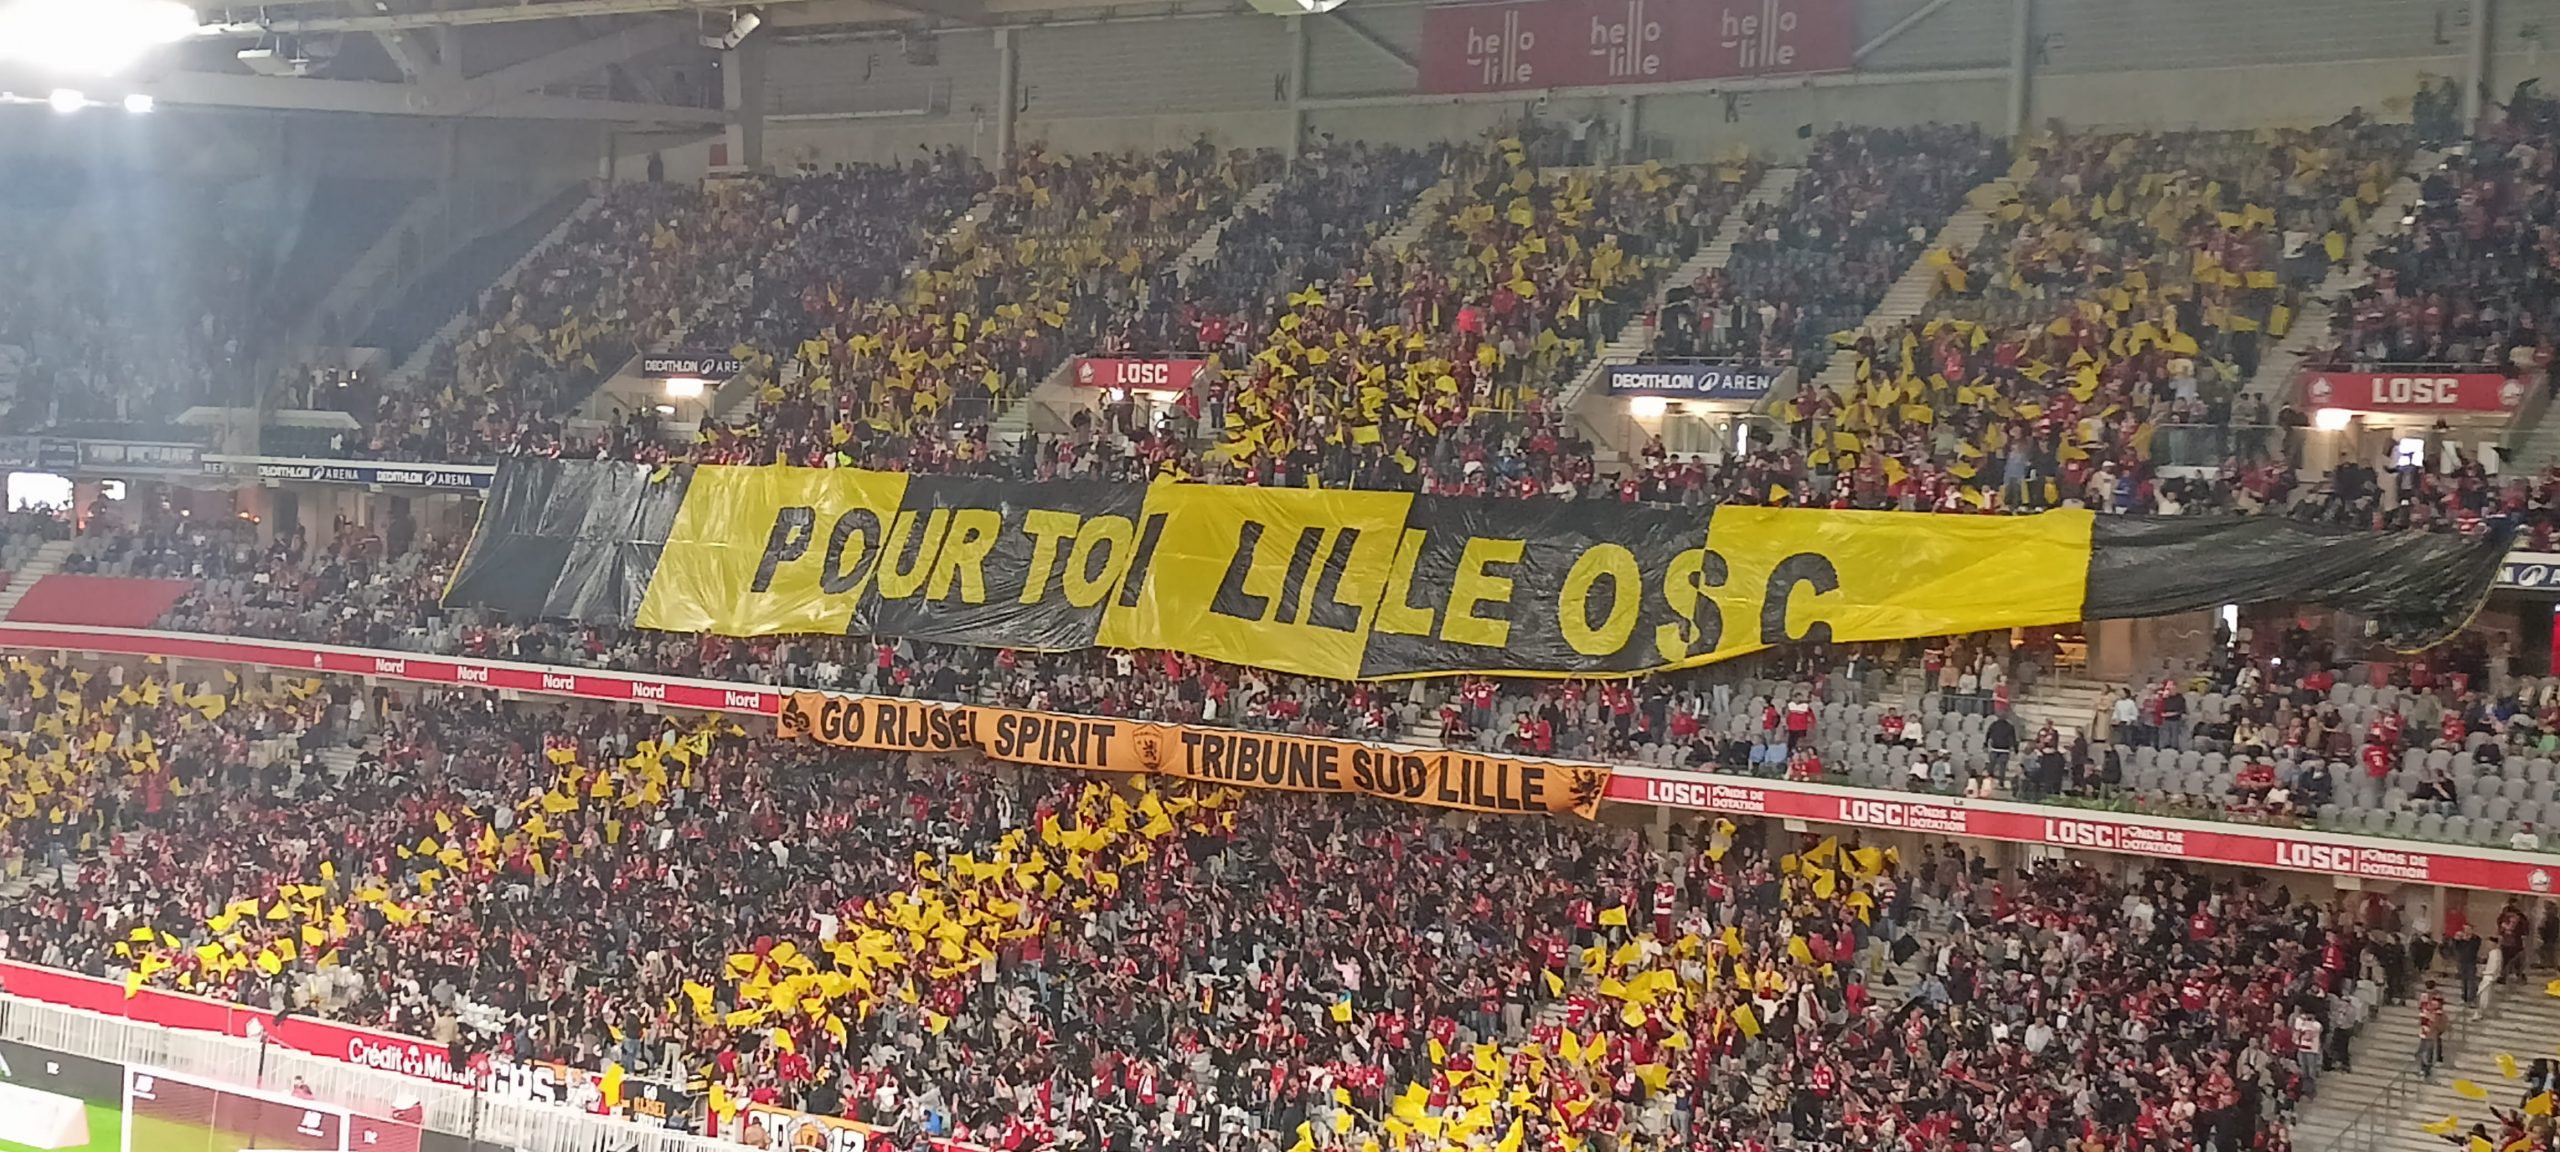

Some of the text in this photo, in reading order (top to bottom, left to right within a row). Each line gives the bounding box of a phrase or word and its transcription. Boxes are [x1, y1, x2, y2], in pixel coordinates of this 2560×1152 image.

[1591, 0, 1661, 46] hello
[1722, 0, 1797, 37] hello
[1468, 10, 1534, 55] hello
[1117, 363, 1168, 383] LOSC
[1612, 373, 1694, 388] DECATHLON
[2372, 378, 2459, 404] LOSC
[324, 467, 359, 480] ARENA
[436, 473, 472, 486] ARENA
[751, 505, 1842, 663] POUR TOI LILLE OSC
[375, 658, 405, 674] Nord
[457, 666, 488, 682] Nord
[542, 675, 575, 690] Nord
[632, 682, 665, 699] Nord
[725, 691, 760, 708] Nord
[820, 701, 1551, 812] GO RIJSEL SPIRIT TRIBUNE SUD LILLE
[1648, 780, 1706, 806] LOSC
[1839, 799, 1902, 825] LOSC
[2045, 819, 2114, 848] LOSC
[2275, 842, 2351, 870] LOSC
[348, 1037, 403, 1071] Crédit
